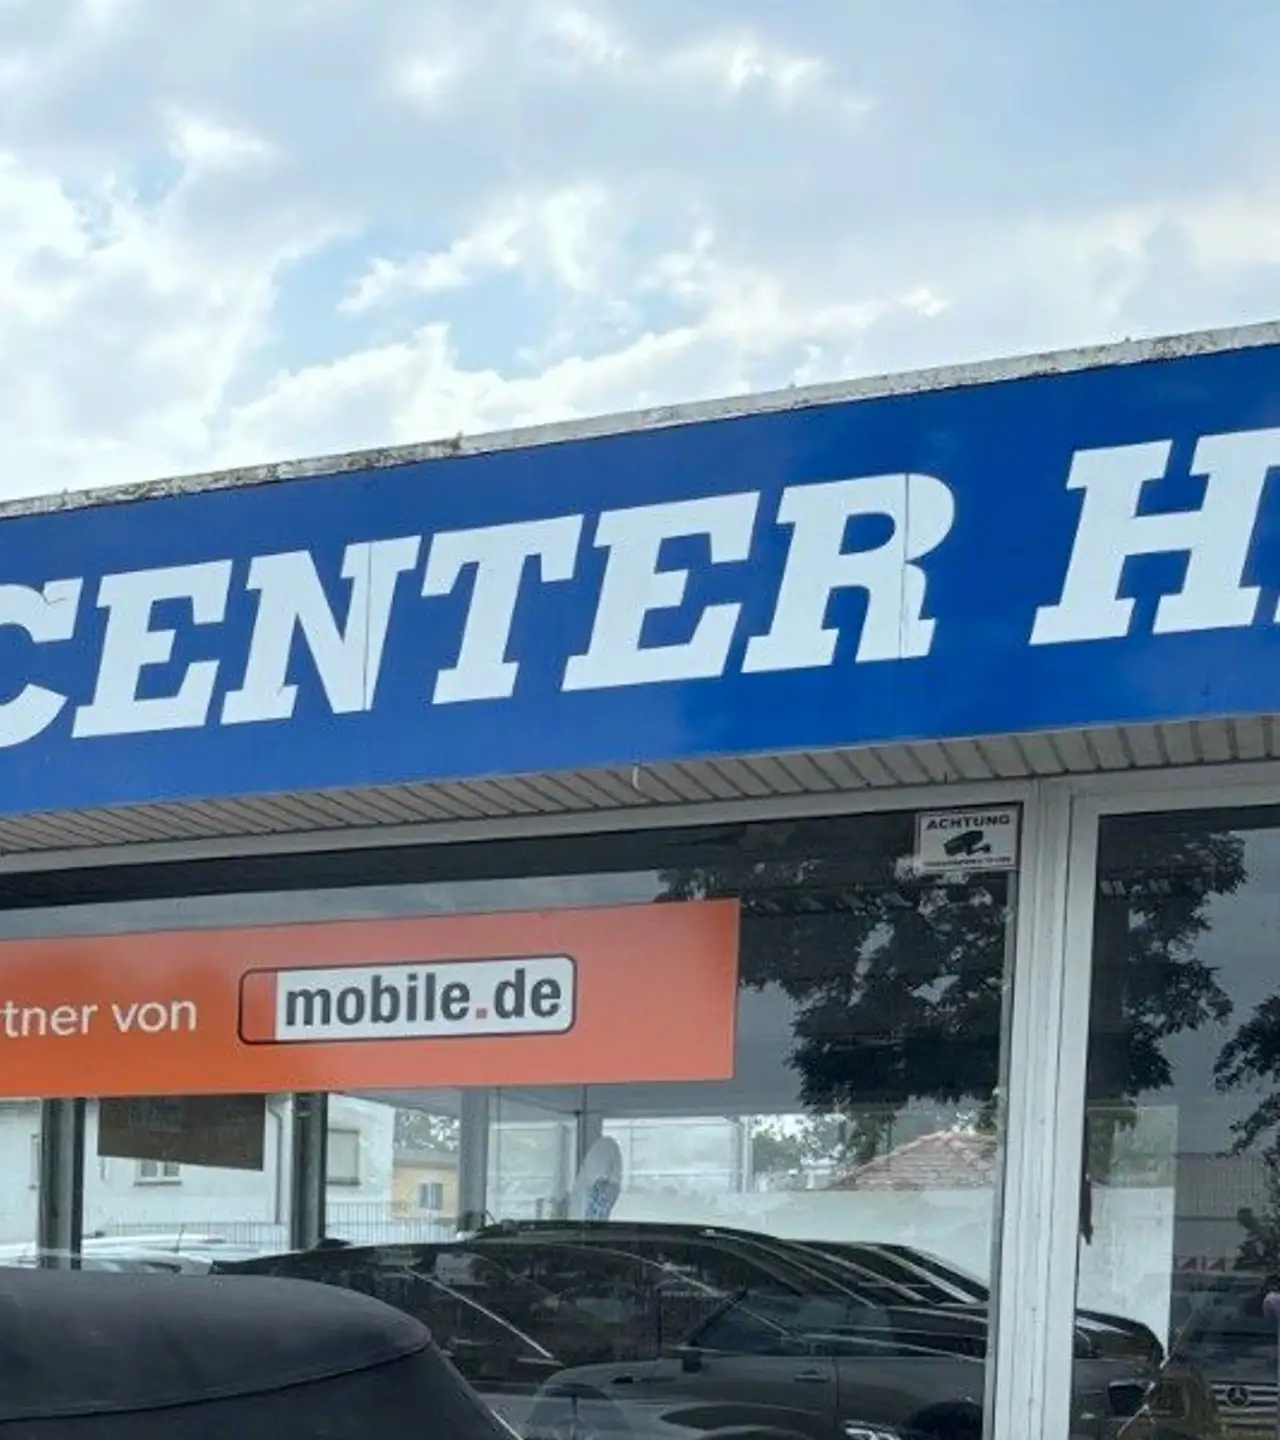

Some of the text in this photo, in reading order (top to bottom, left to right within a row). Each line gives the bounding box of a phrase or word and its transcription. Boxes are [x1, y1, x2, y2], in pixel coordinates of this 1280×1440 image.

[1028, 426, 1280, 646] H
[925, 814, 1010, 830] ACHTUNG
[110, 999, 198, 1034] von
[284, 967, 562, 1028] mobile.de
